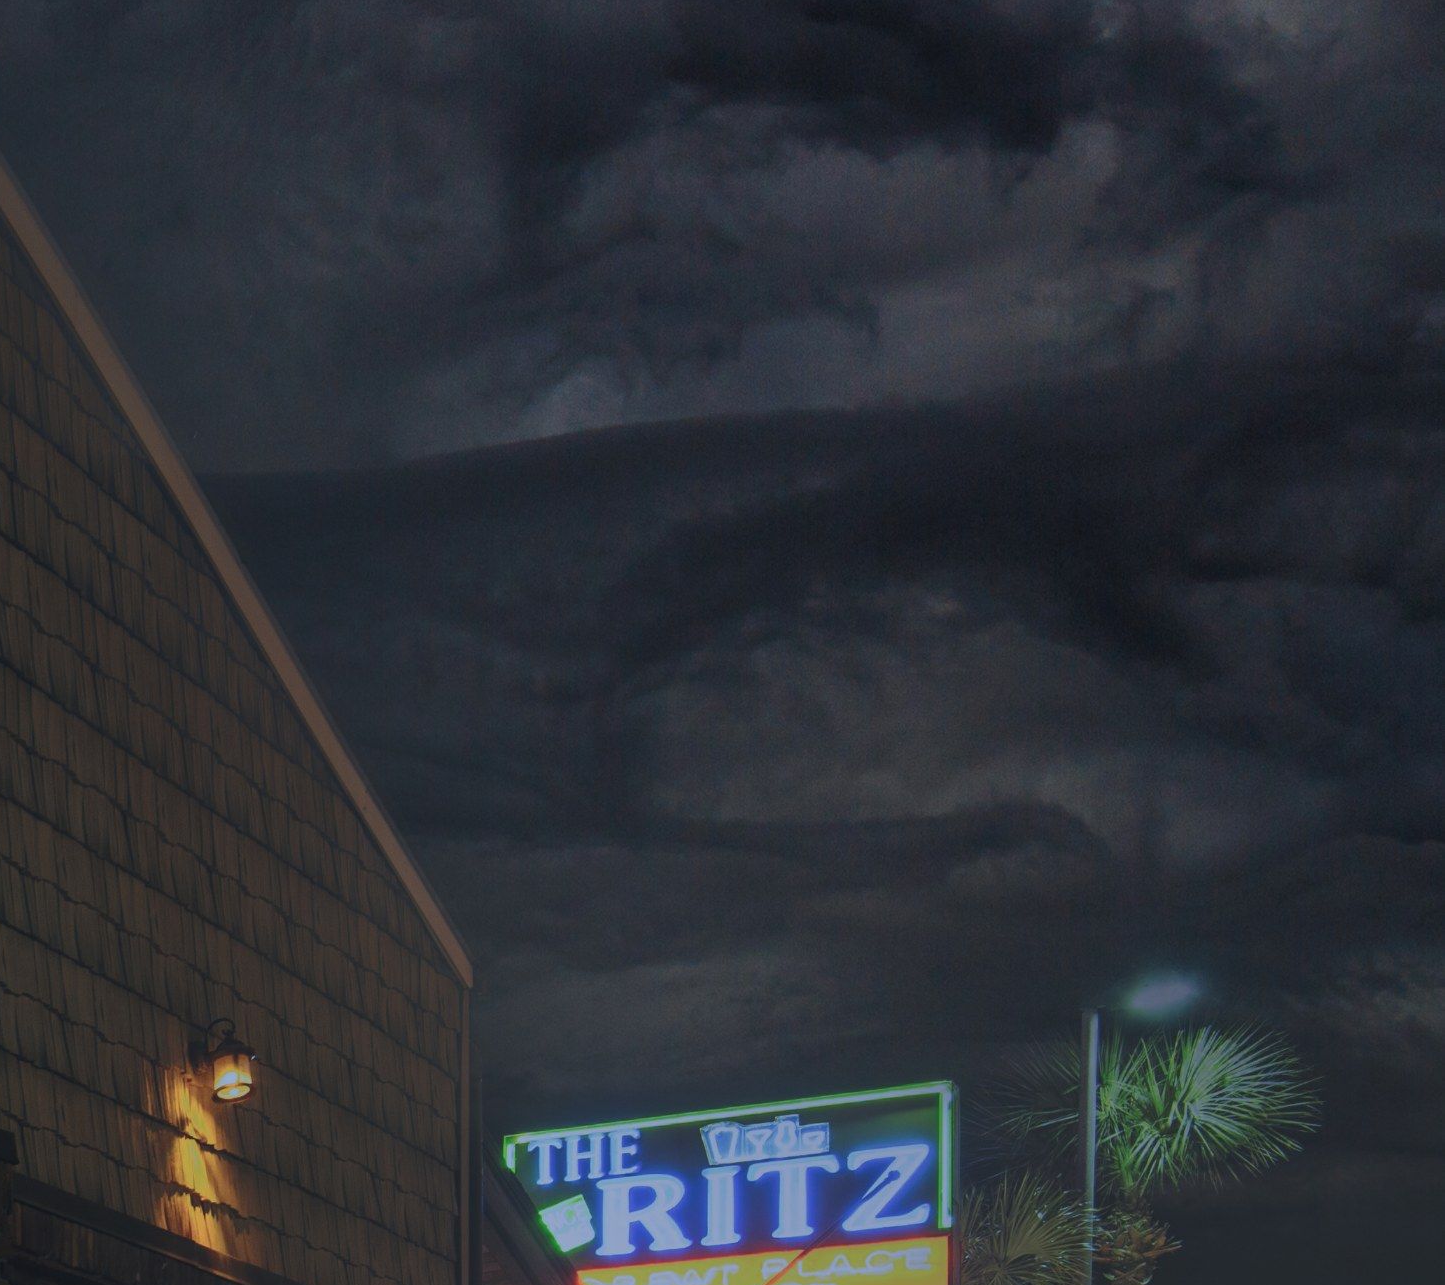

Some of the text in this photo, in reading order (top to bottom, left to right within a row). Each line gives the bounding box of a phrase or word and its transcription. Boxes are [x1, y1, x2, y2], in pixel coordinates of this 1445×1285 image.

[527, 1129, 642, 1186] THE
[595, 1143, 932, 1256] RITZ
[761, 1247, 932, 1280] PLACE
